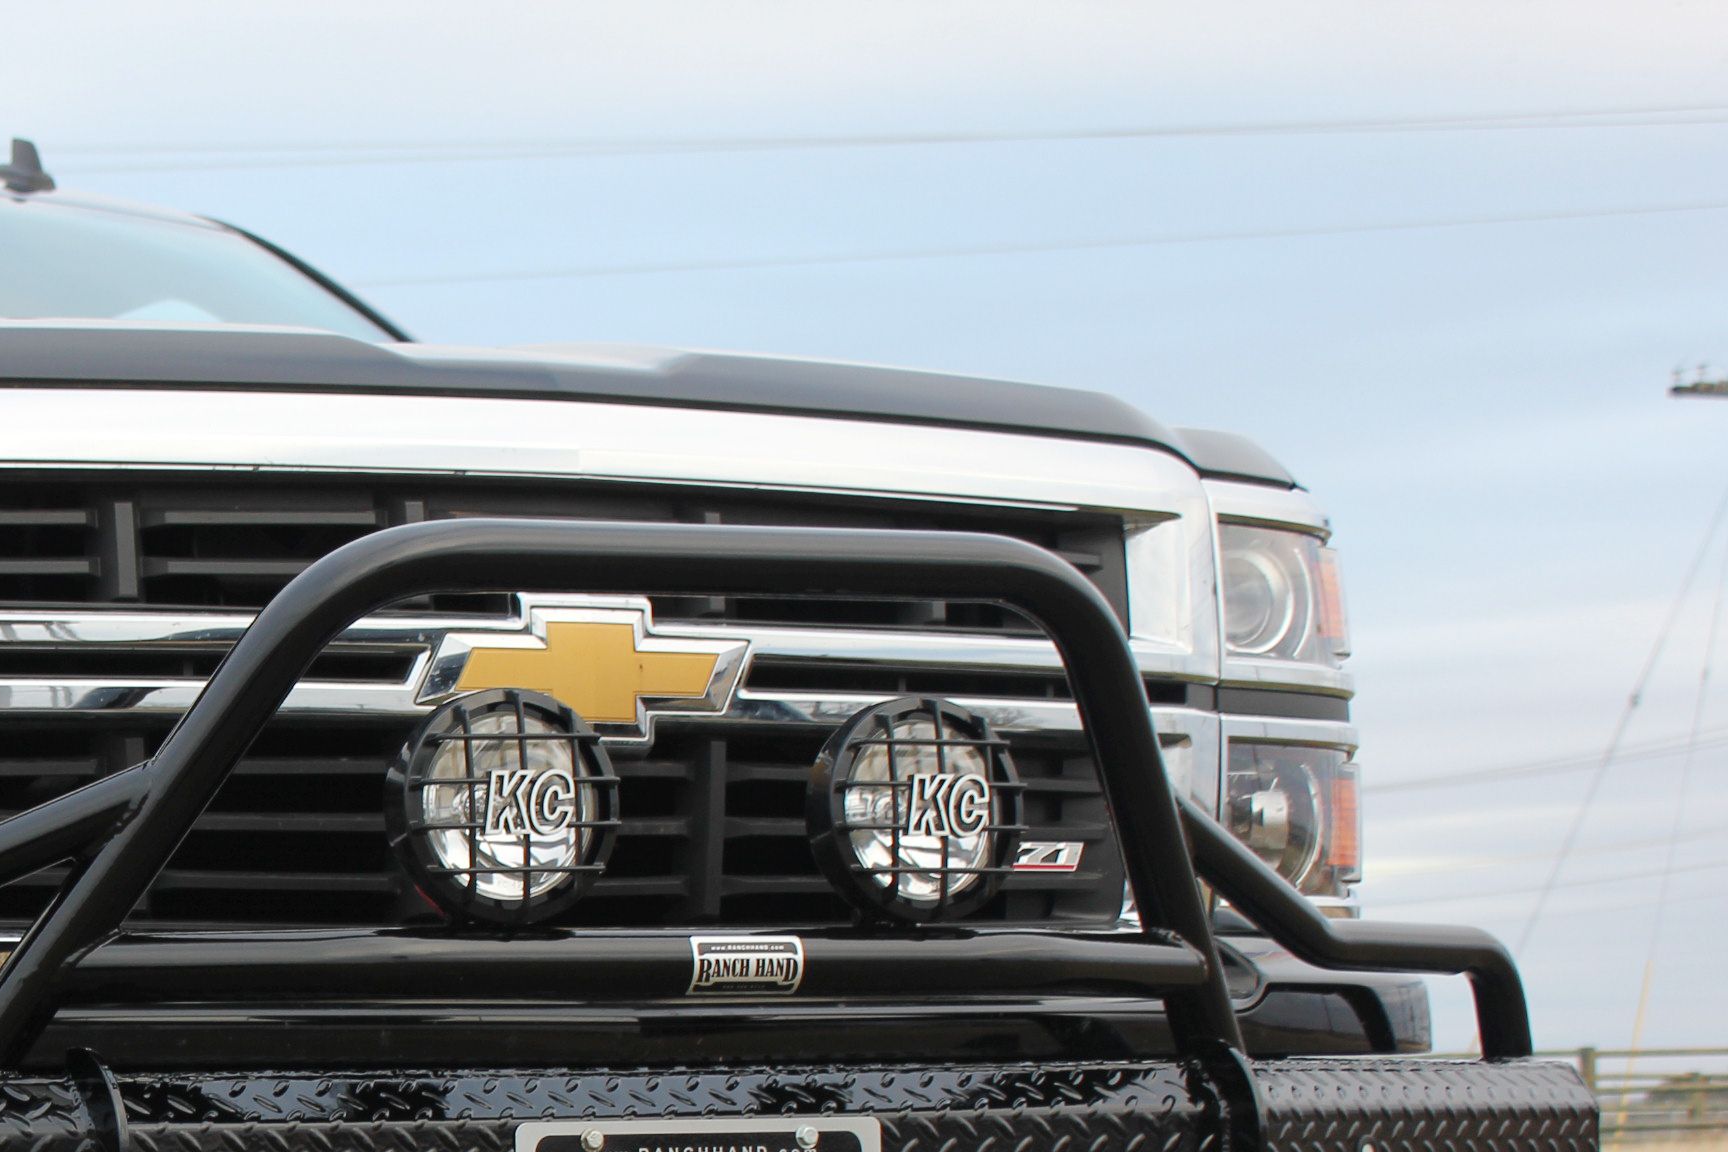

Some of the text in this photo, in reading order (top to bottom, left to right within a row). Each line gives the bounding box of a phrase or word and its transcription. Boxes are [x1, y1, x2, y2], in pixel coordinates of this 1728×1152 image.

[484, 768, 576, 837] KC
[908, 773, 990, 838] KC
[696, 957, 799, 983] RANCH HAND
